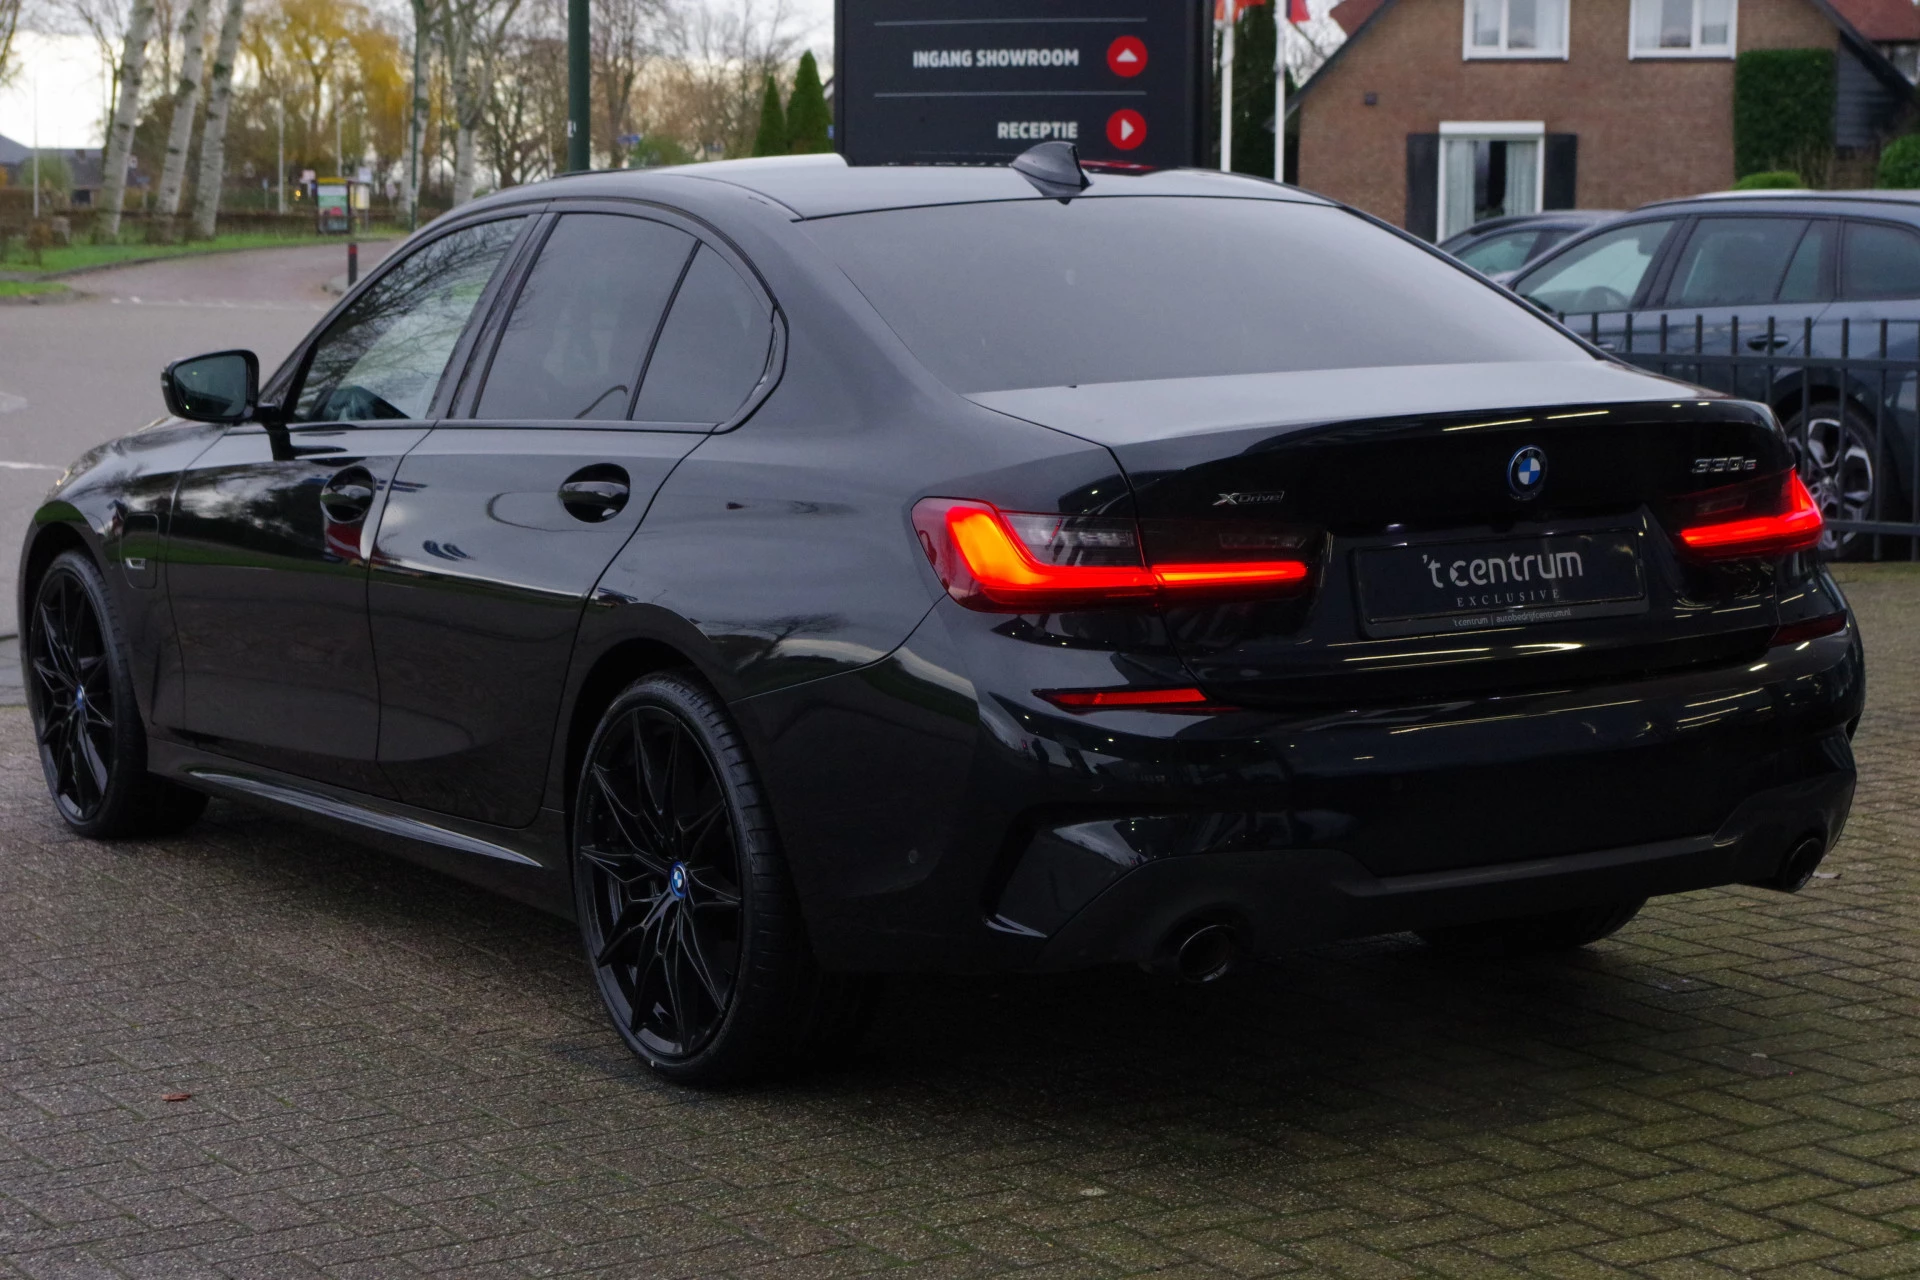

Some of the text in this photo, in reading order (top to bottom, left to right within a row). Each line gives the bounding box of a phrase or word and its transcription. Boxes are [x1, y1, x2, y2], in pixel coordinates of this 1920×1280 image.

[912, 49, 1080, 68] INGANG SHOWROOM
[997, 121, 1079, 139] RECEPTIE
[1449, 551, 1584, 587] centrum
[1456, 588, 1561, 608] EXCLUSIVE
